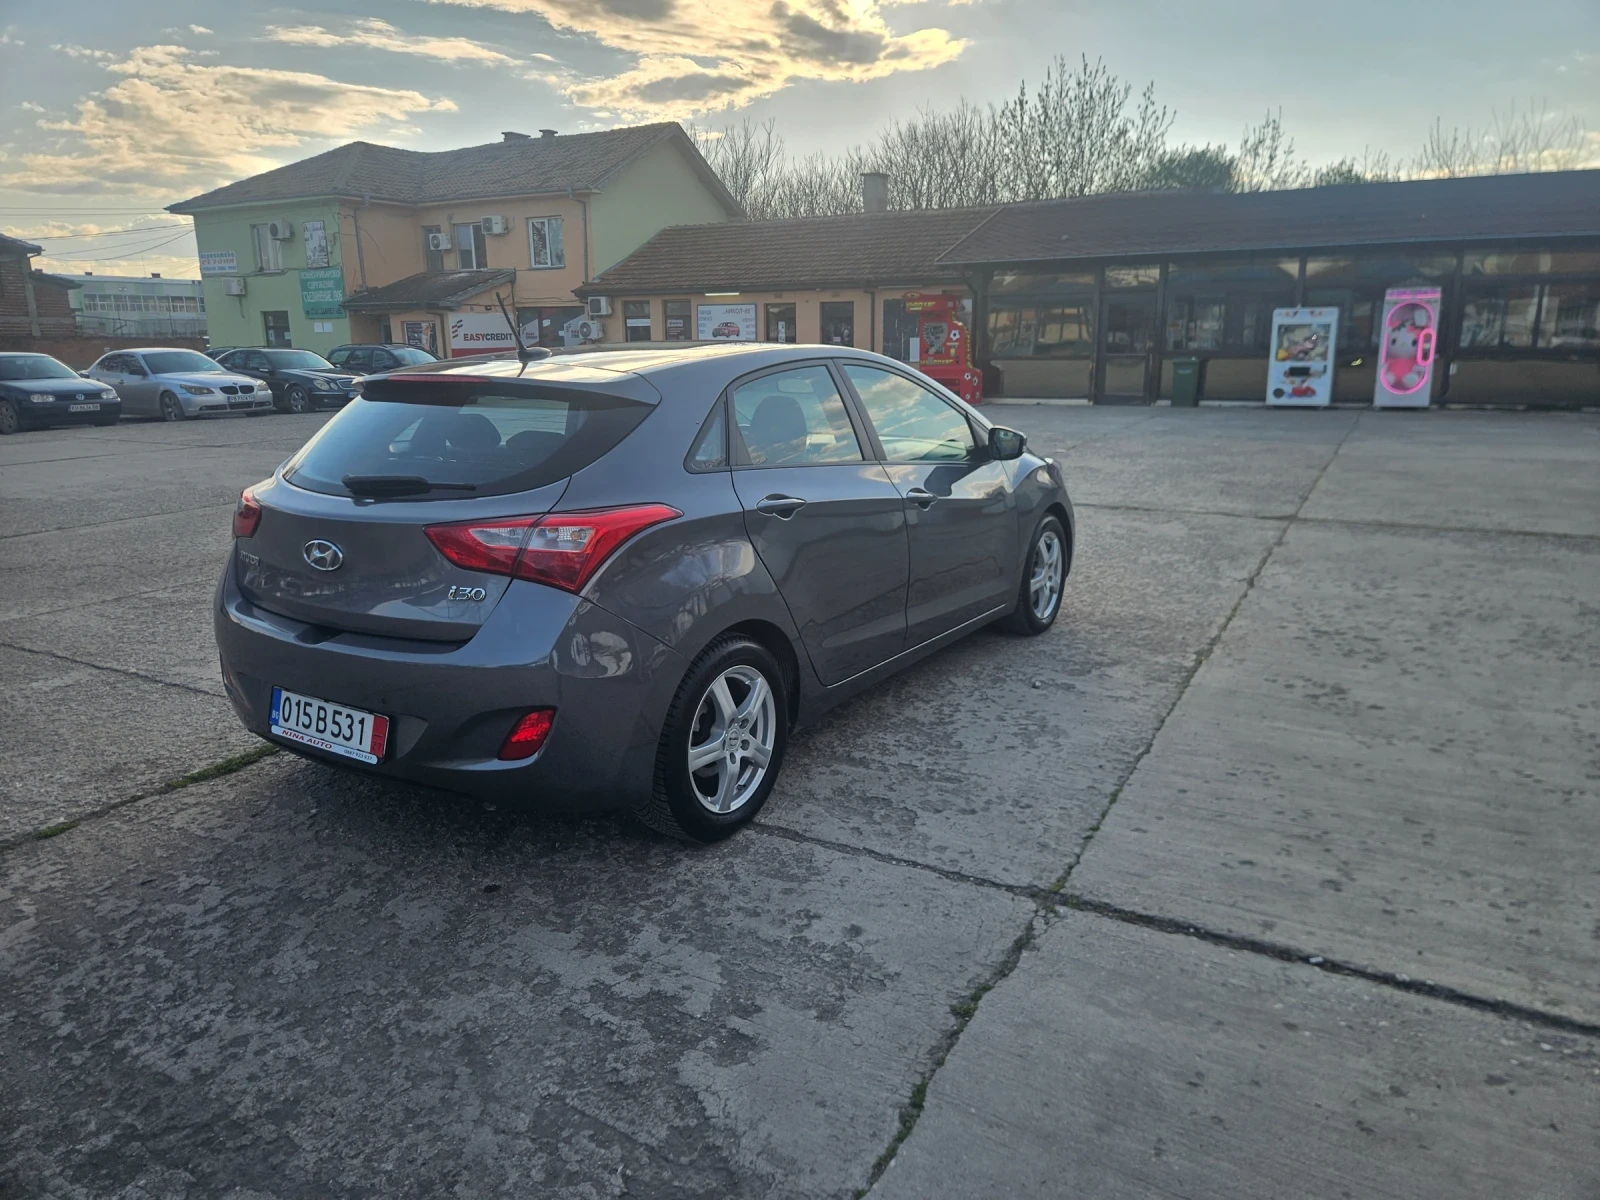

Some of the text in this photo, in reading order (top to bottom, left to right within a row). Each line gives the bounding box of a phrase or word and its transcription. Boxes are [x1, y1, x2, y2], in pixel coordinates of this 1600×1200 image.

[463, 332, 513, 342] EASYCREDIT
[447, 585, 487, 602] i30
[271, 709, 280, 720] BG
[282, 696, 366, 746] 015B531
[281, 729, 333, 749] NINA AUTO
